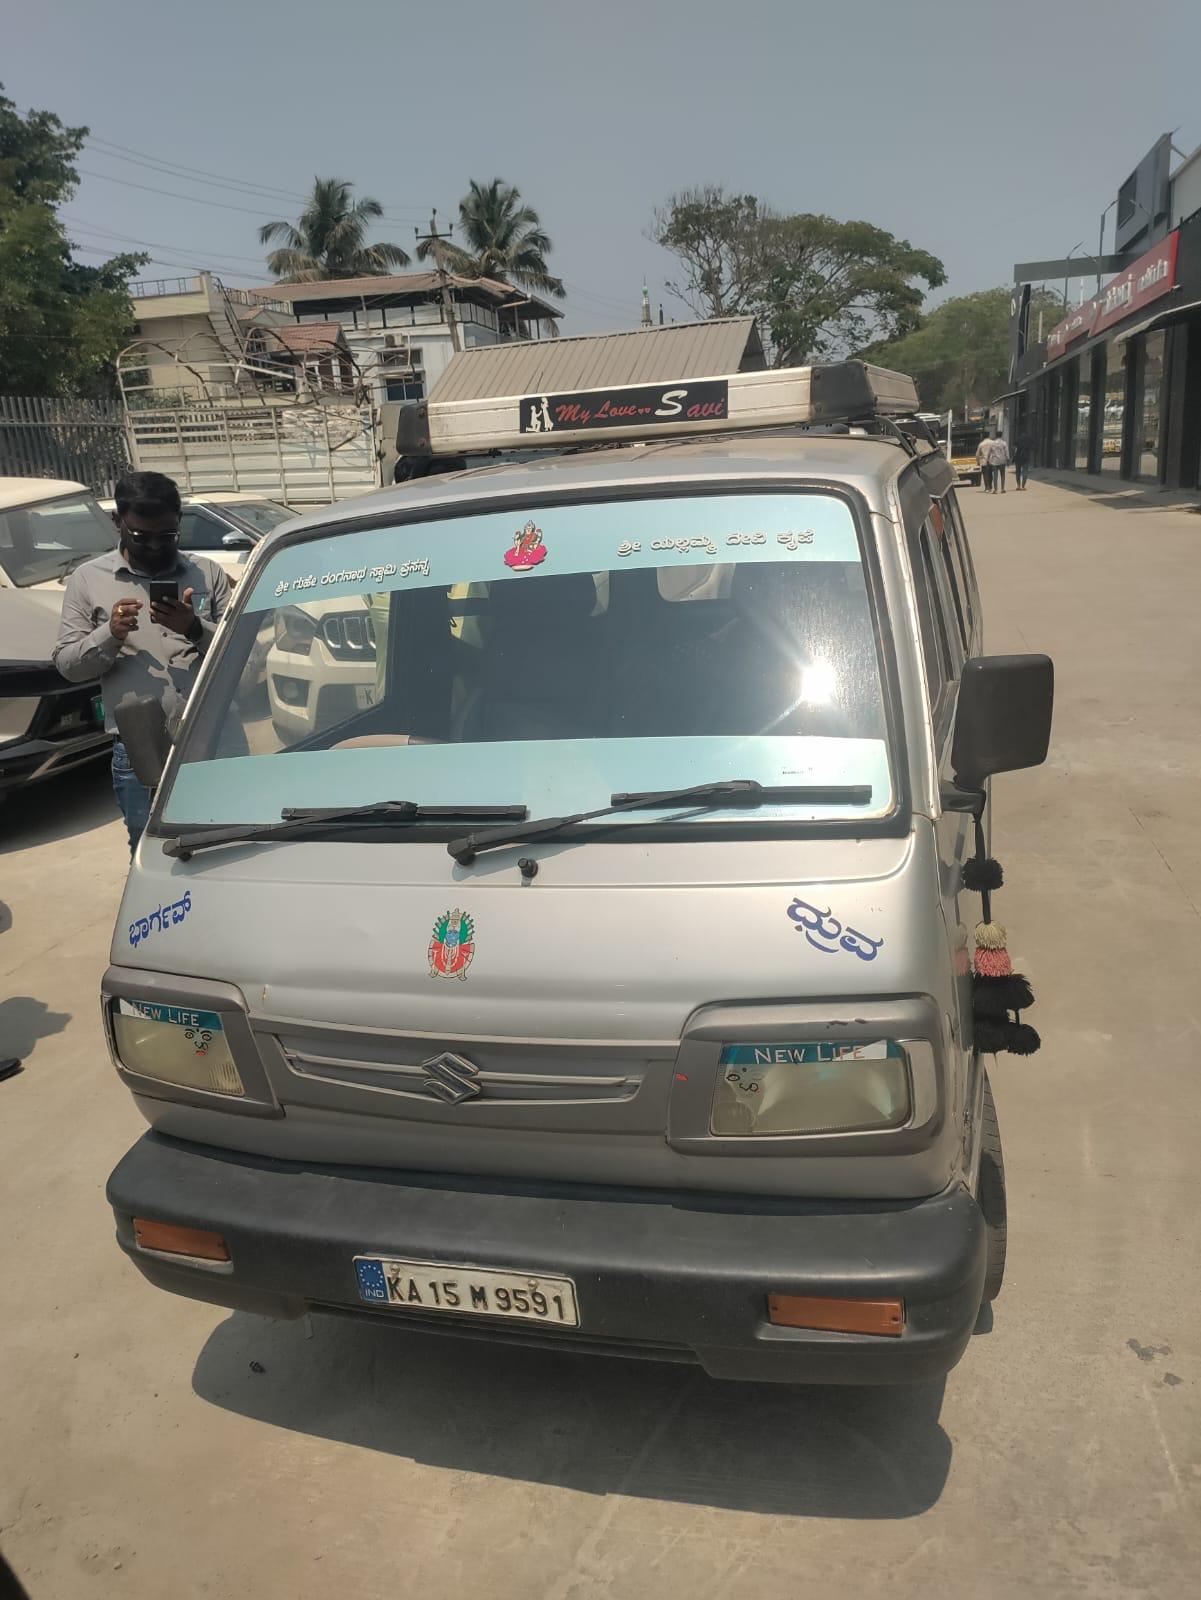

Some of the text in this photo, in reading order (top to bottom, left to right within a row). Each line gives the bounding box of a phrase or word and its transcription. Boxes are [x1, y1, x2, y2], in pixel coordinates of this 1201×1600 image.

[555, 404, 591, 424] My
[617, 539, 642, 556] ಶ್ರೀ
[274, 579, 289, 597] ಶ್ರೀ
[168, 1008, 201, 1026] LIFE
[754, 1043, 867, 1064] NEW LIFE
[364, 1288, 385, 1299] IND
[386, 1275, 565, 1320] KA 15 M 9591
